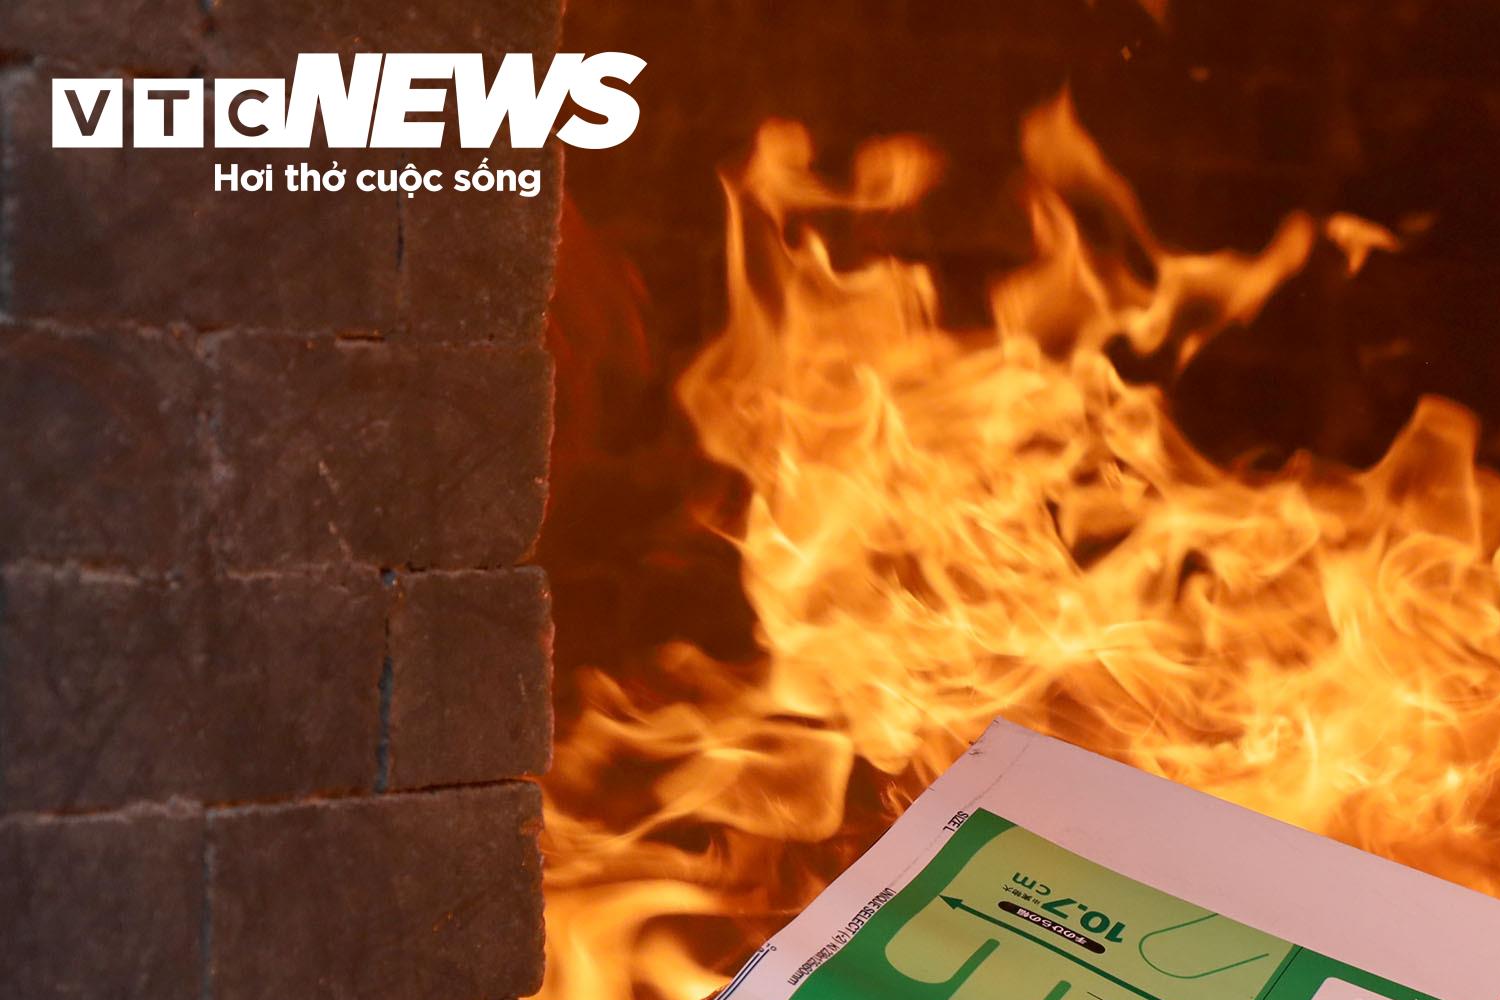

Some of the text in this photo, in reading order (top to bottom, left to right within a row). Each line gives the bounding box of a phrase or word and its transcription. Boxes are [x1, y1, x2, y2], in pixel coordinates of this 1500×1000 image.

[947, 810, 969, 827] SIZE
[866, 887, 897, 909] UNIQUE
[1009, 872, 1126, 944] 10.7cm
[842, 905, 876, 934] SELECT
[1015, 908, 1088, 944] 手のひらの幅
